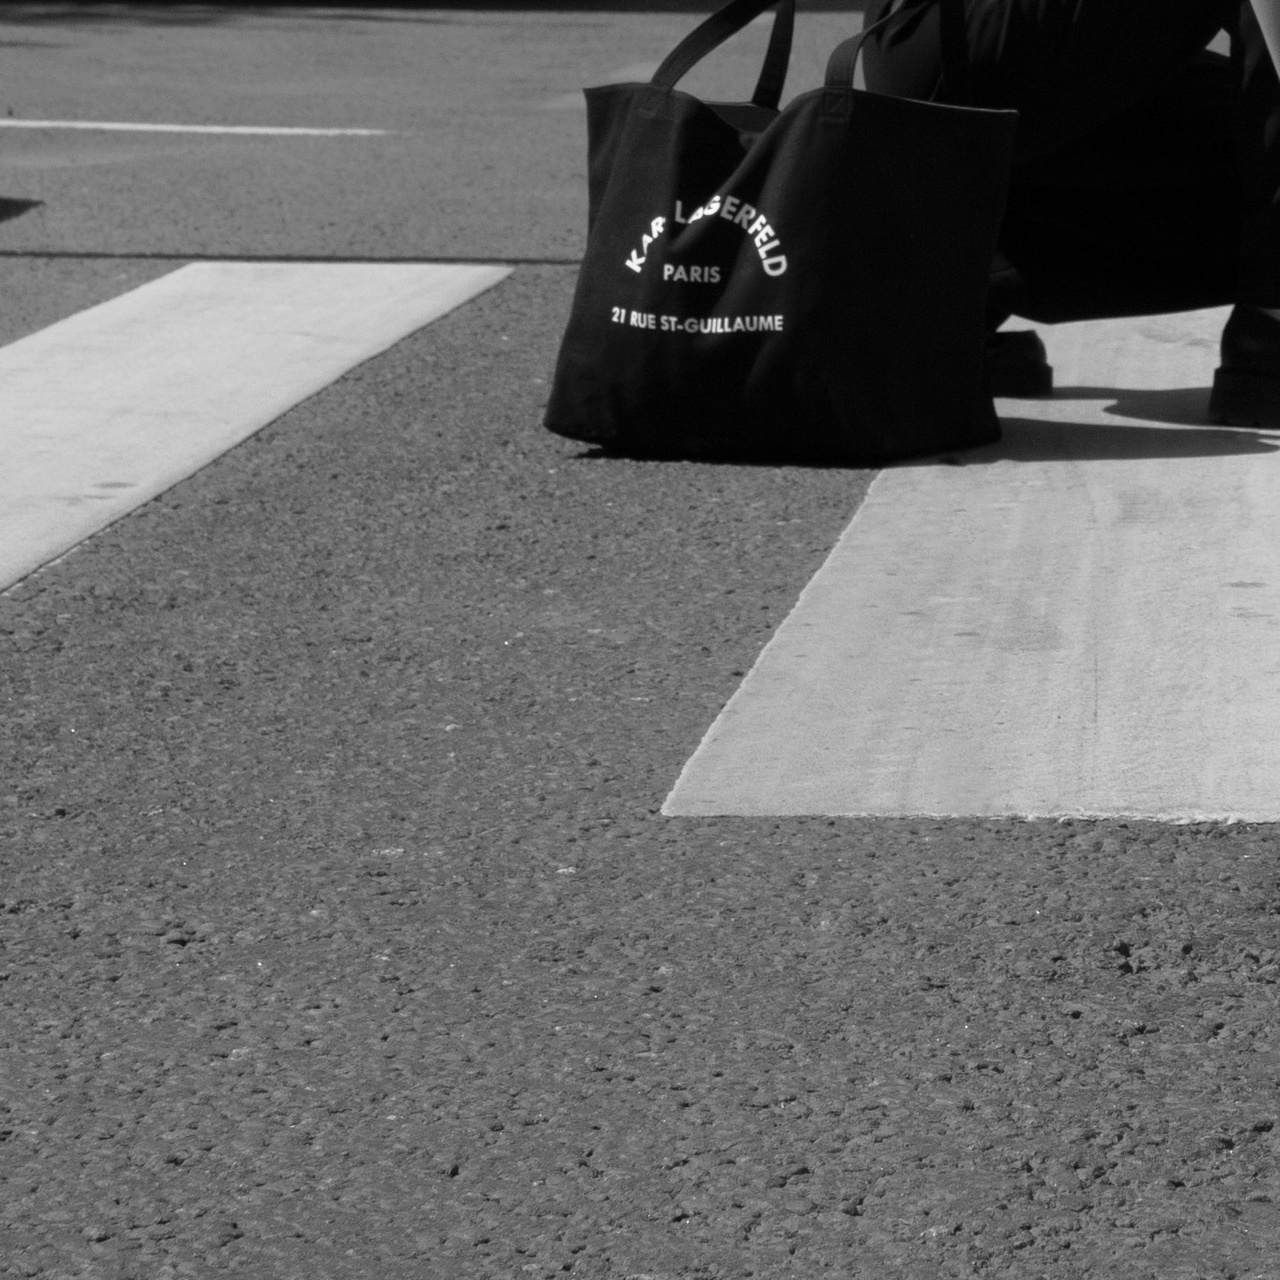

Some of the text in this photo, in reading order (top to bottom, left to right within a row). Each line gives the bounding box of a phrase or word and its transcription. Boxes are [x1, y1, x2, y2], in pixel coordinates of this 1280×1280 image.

[625, 194, 788, 277] KAR LAGERFELD
[662, 263, 721, 283] PARIS
[611, 306, 784, 333] 21 RUE ST-GUILLAUME
